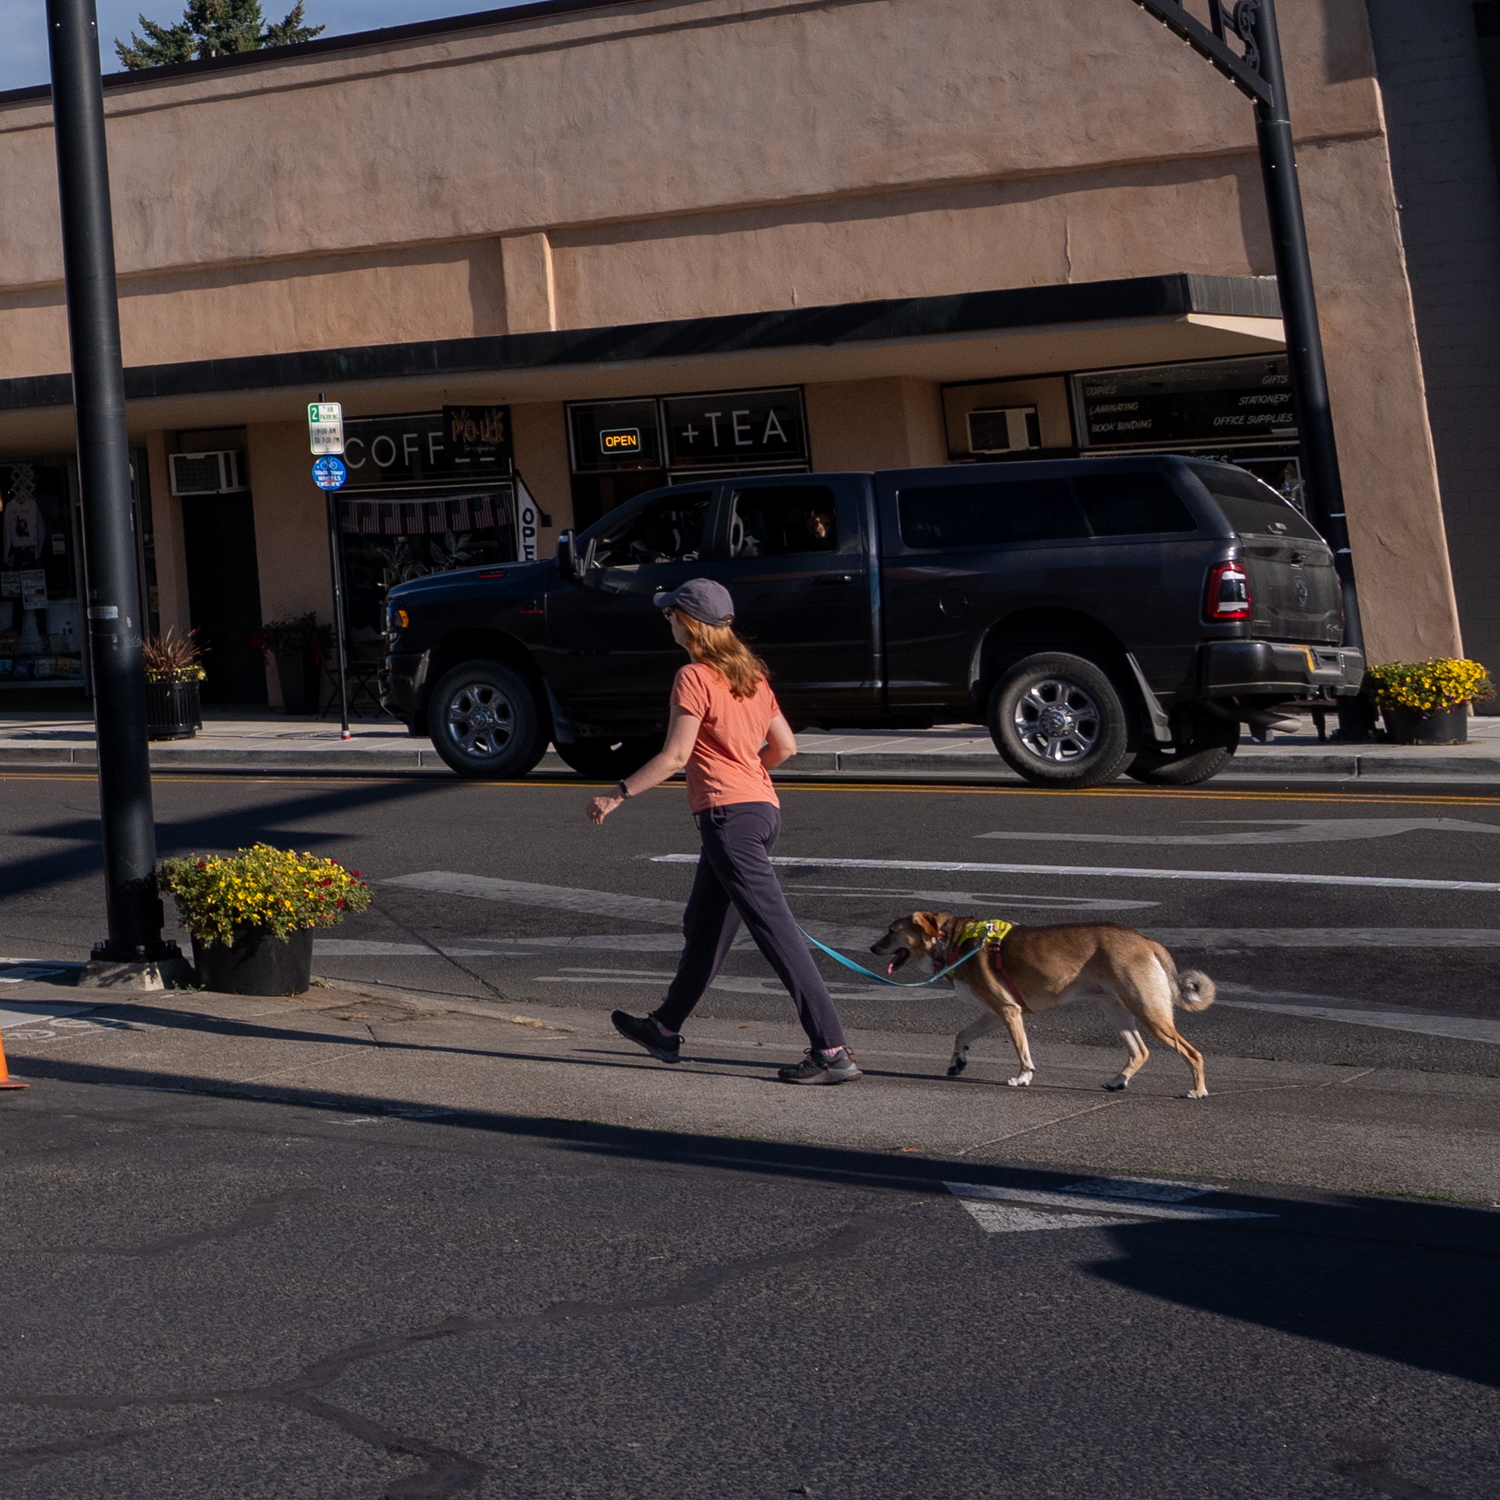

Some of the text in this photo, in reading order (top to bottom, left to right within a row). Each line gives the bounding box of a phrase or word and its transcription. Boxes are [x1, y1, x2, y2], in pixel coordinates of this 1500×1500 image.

[1262, 375, 1289, 386] GIFTS
[1085, 385, 1117, 397] COPIES
[1238, 393, 1292, 406] STATIONERY
[311, 407, 318, 420] 2
[1089, 402, 1139, 416] LAMINATING
[1091, 419, 1153, 433] BOOK BINDING
[1213, 413, 1294, 426] OFFICE SUPPLIES
[451, 419, 505, 442] POUR
[605, 434, 637, 448] OPEN
